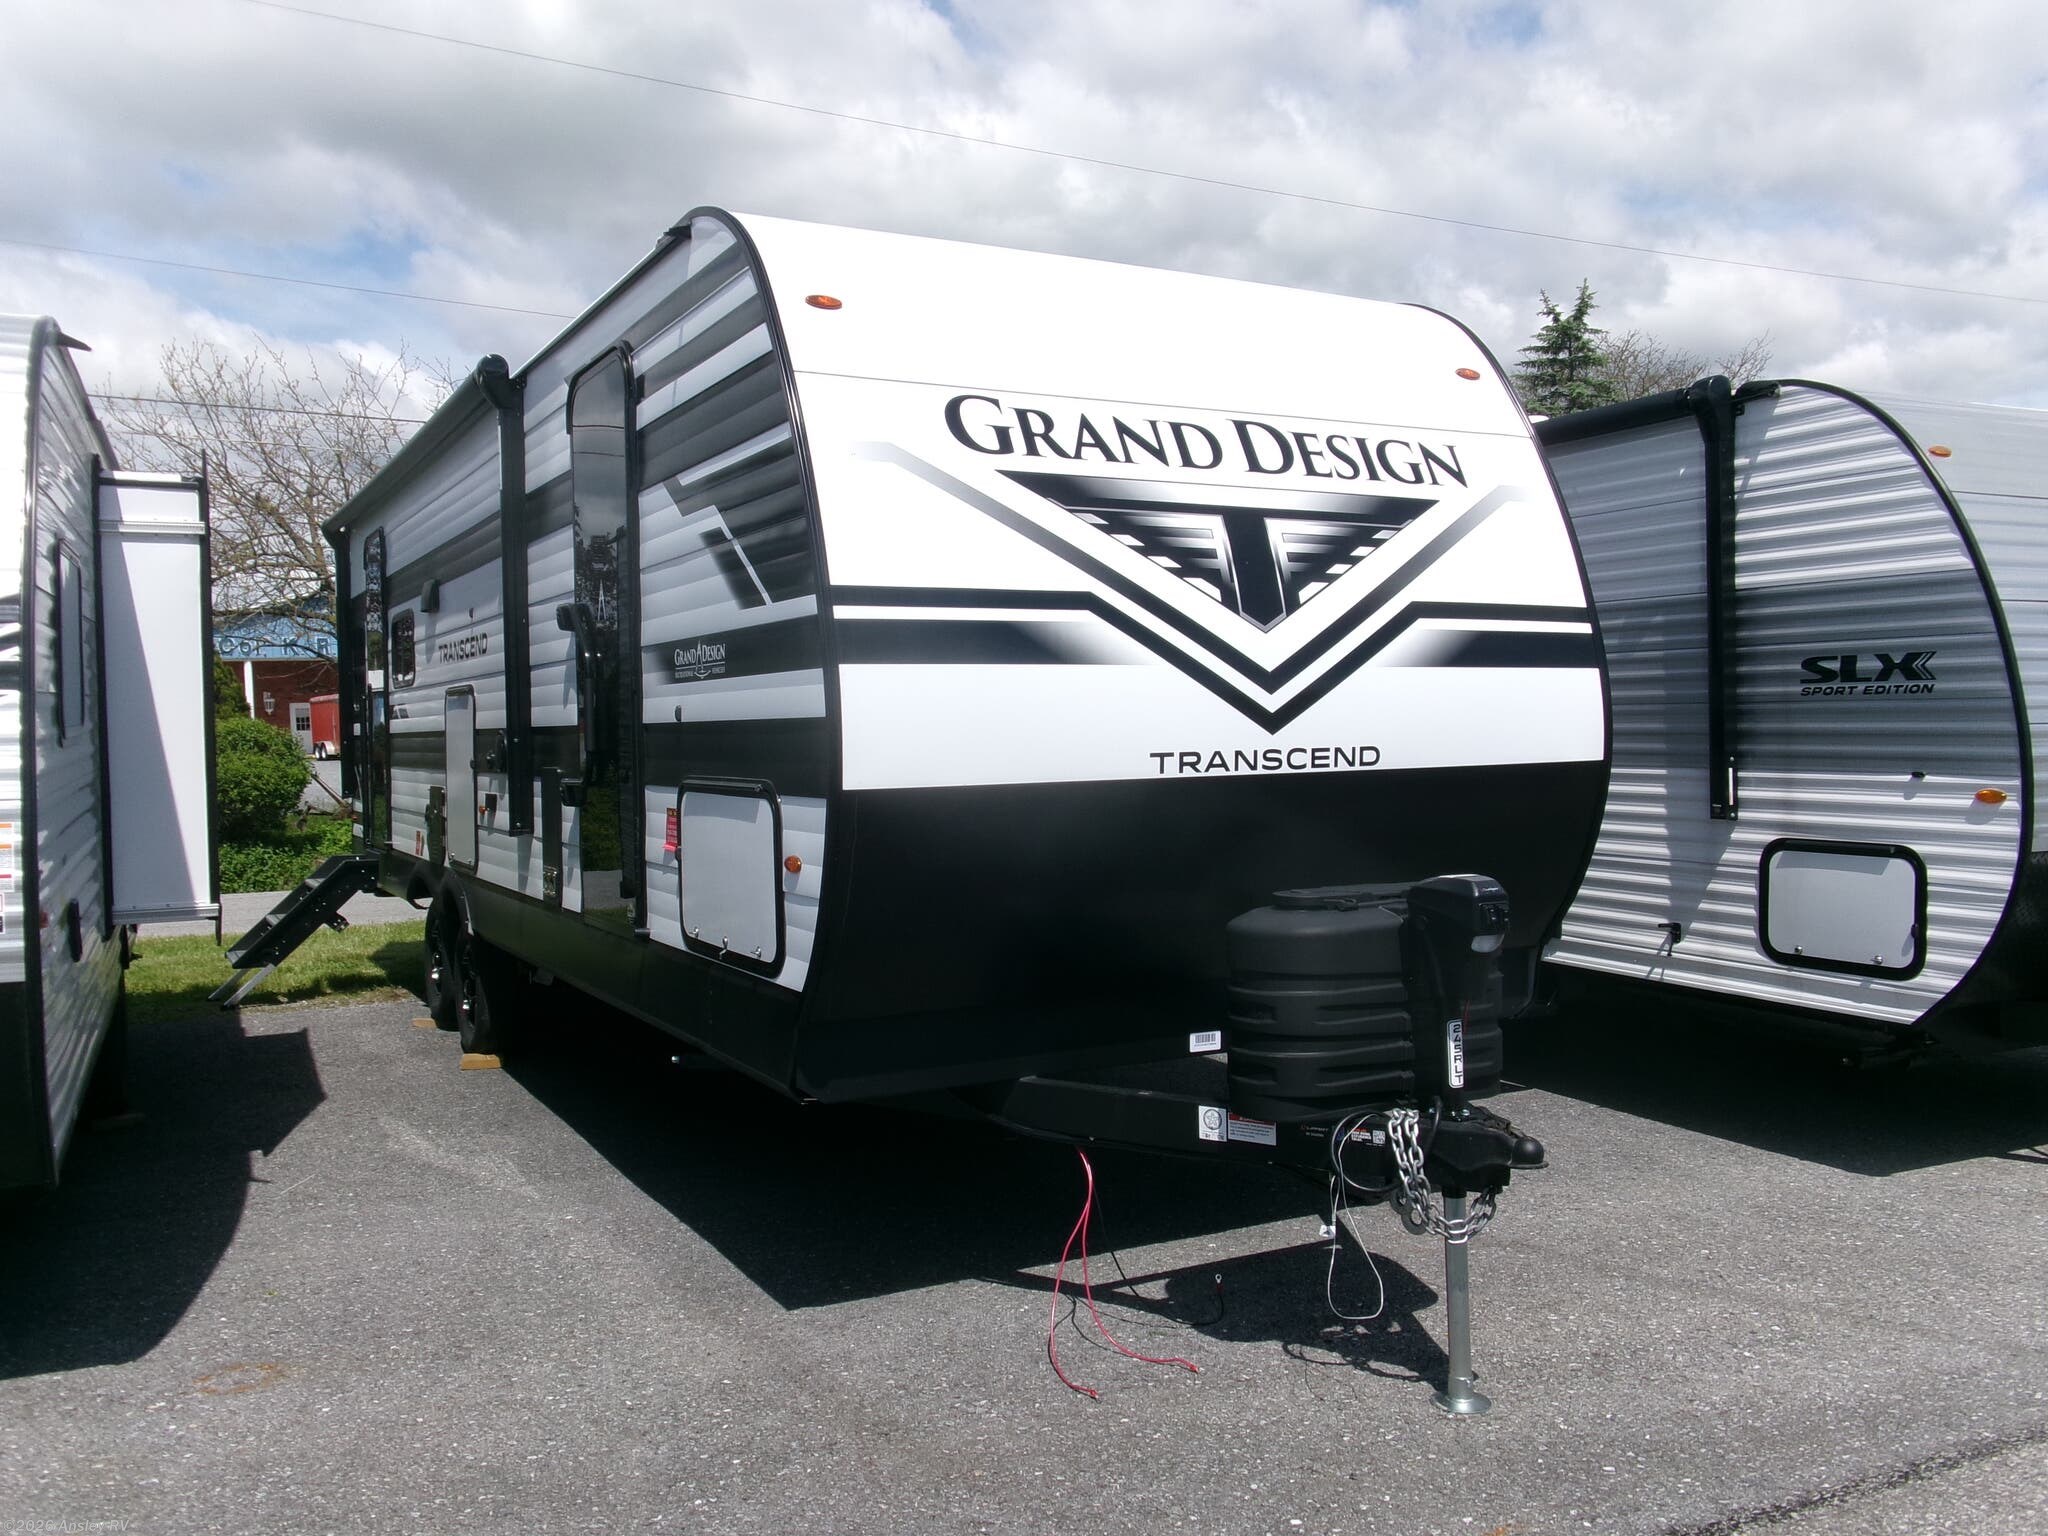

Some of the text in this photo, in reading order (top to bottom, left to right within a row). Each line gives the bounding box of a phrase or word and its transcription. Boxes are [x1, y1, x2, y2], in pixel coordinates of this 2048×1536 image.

[944, 394, 1468, 489] GRAND DESIGN
[437, 632, 488, 664] TRANSCEND
[674, 643, 726, 666] GRAND DESIGN
[1800, 651, 1937, 684] SLX
[1801, 683, 1936, 697] SPORT EDITION
[1149, 745, 1381, 775] TRANSCEND
